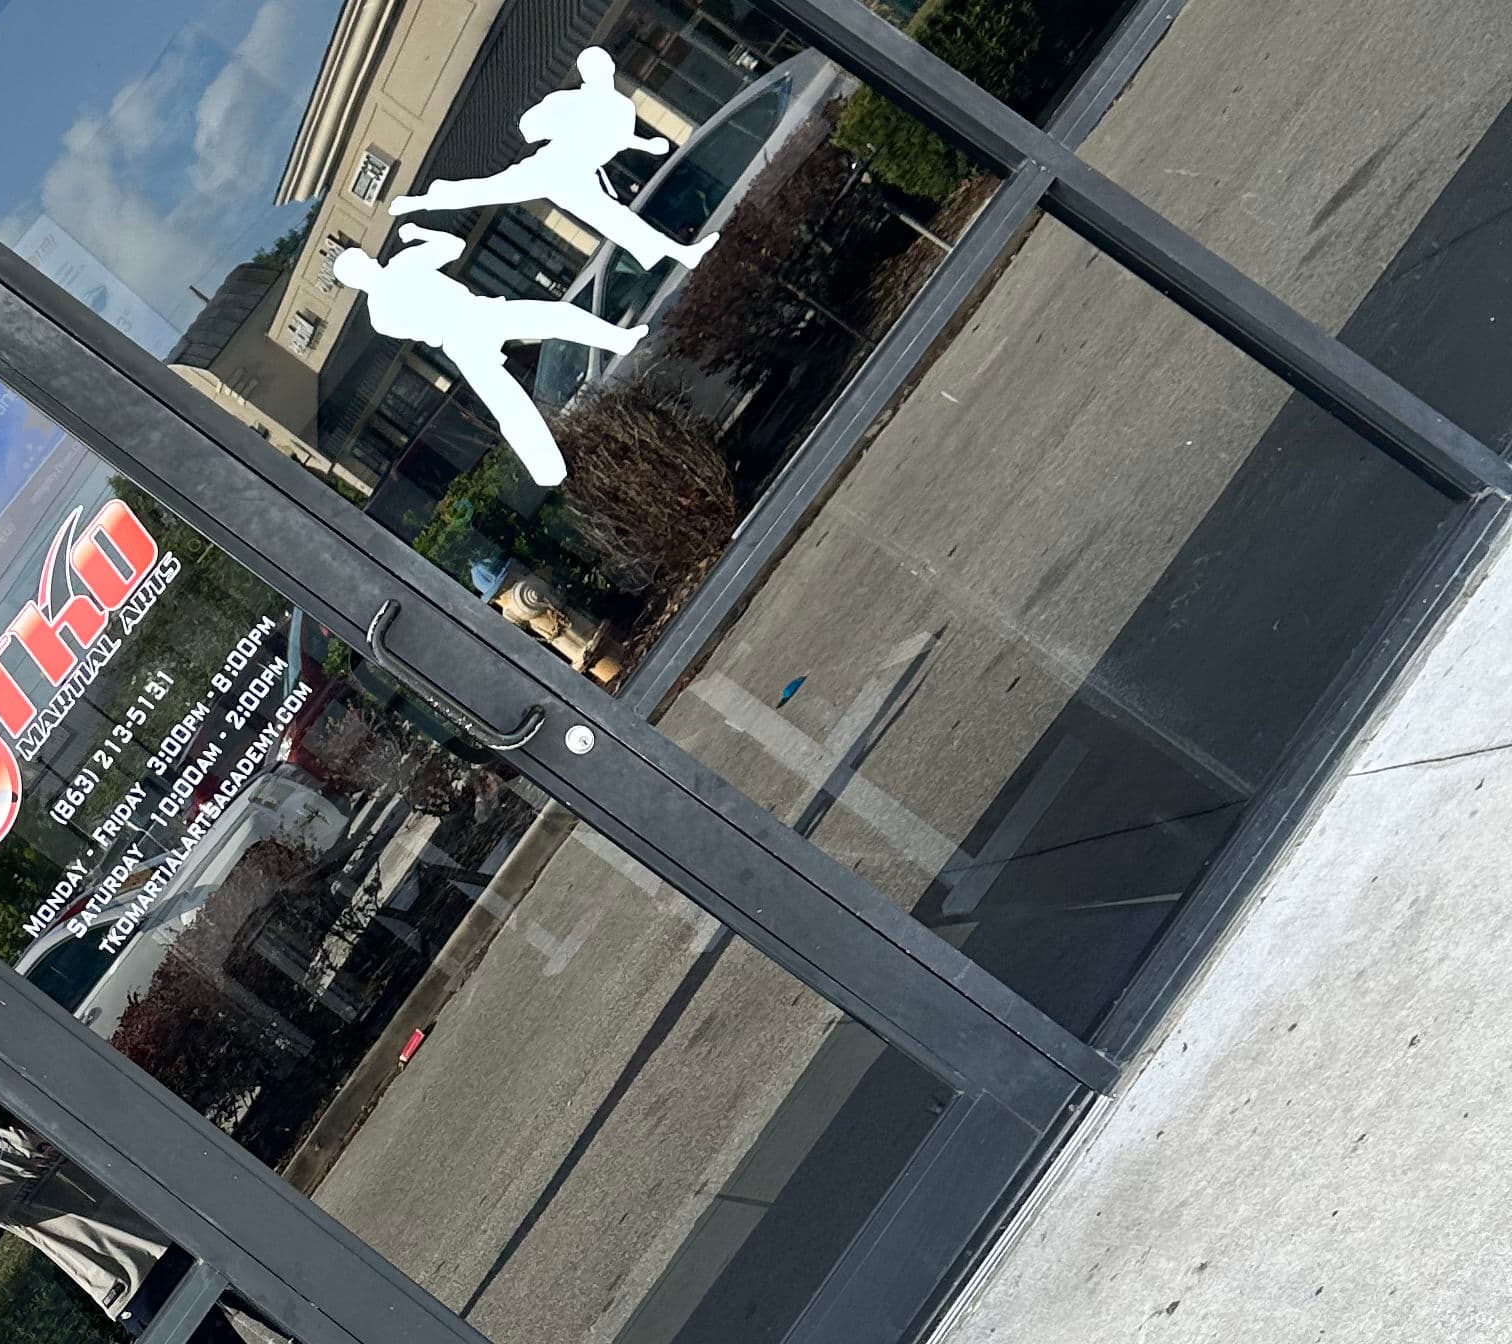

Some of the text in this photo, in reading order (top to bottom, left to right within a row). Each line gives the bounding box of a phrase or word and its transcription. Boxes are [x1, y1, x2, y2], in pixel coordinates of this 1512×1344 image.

[15, 551, 181, 761] MARTIAL ARTS
[146, 701, 211, 776] 3:00PM
[211, 615, 276, 693] 8:00PM
[150, 742, 223, 827] 10:00AM
[225, 655, 289, 730] 2:00PM
[50, 670, 174, 825] (863) 213-5131
[98, 681, 313, 954] TKOMARTIALARTSACADEMY.COM
